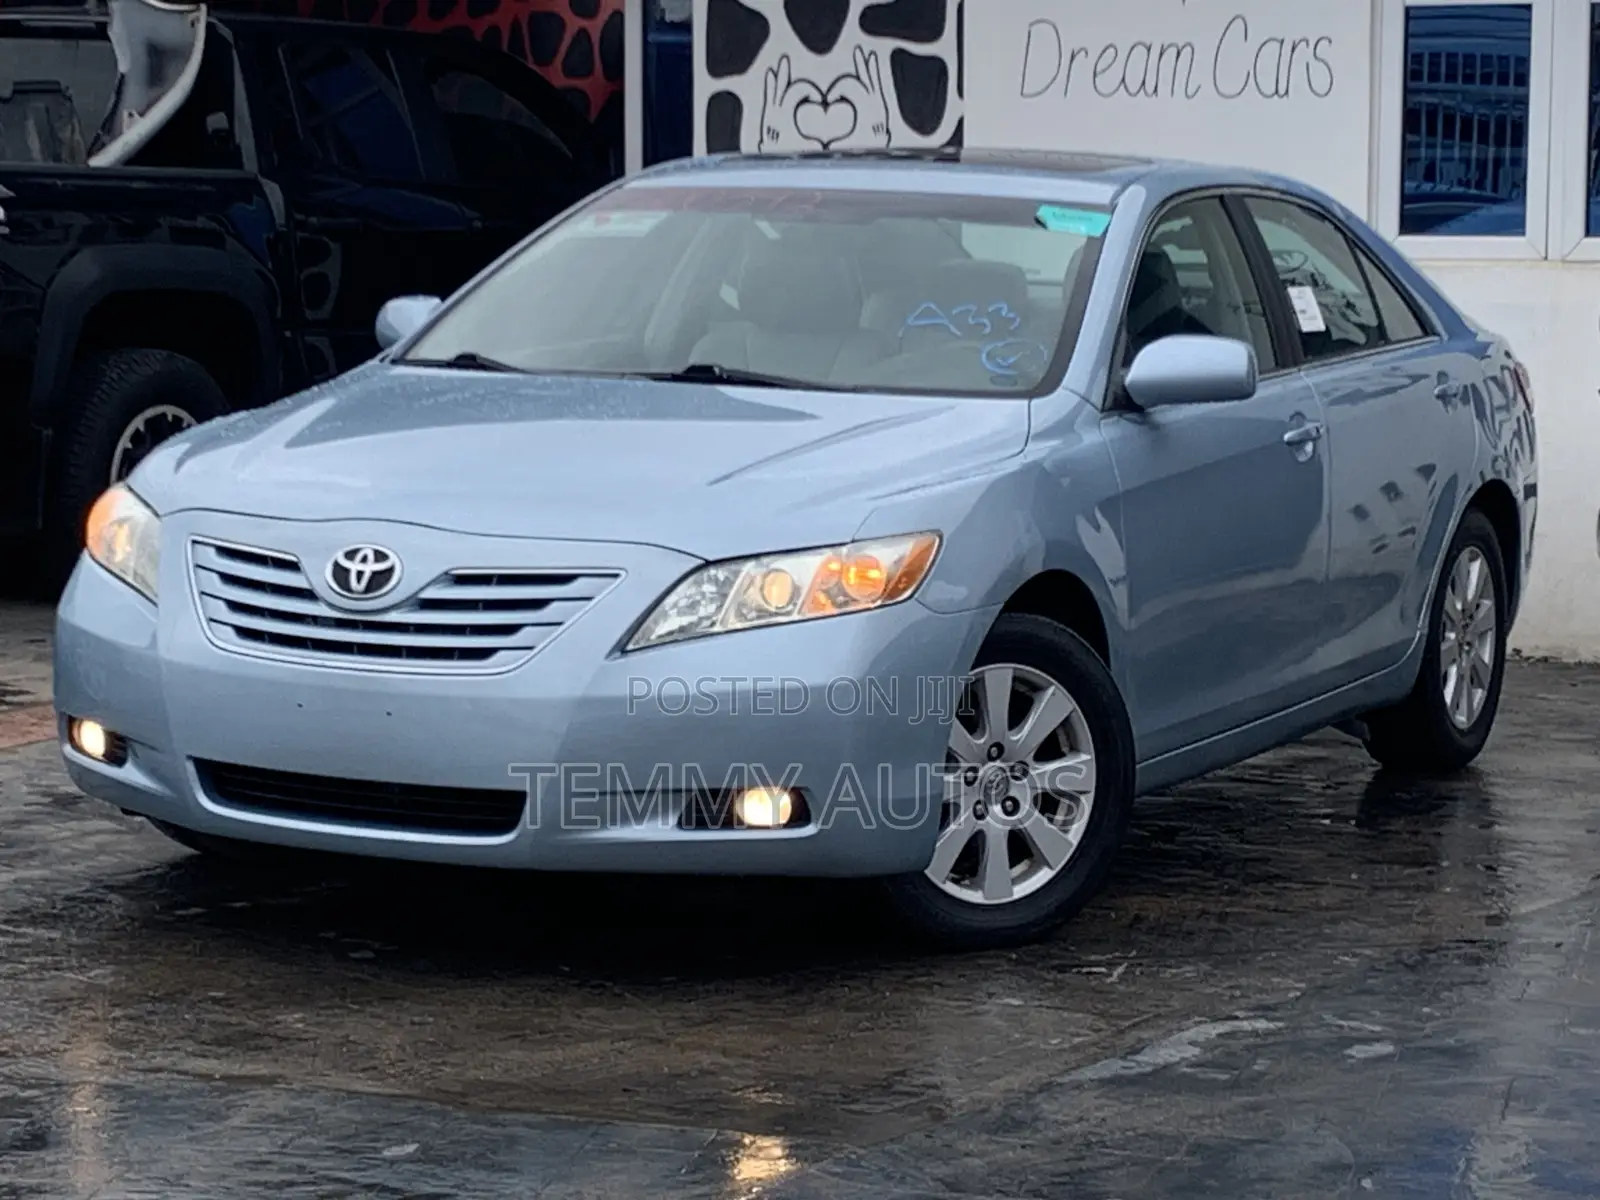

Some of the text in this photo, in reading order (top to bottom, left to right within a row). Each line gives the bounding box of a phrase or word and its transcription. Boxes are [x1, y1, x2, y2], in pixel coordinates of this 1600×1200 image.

[1020, 14, 1334, 100] Dream Cars
[897, 301, 1021, 337] A33
